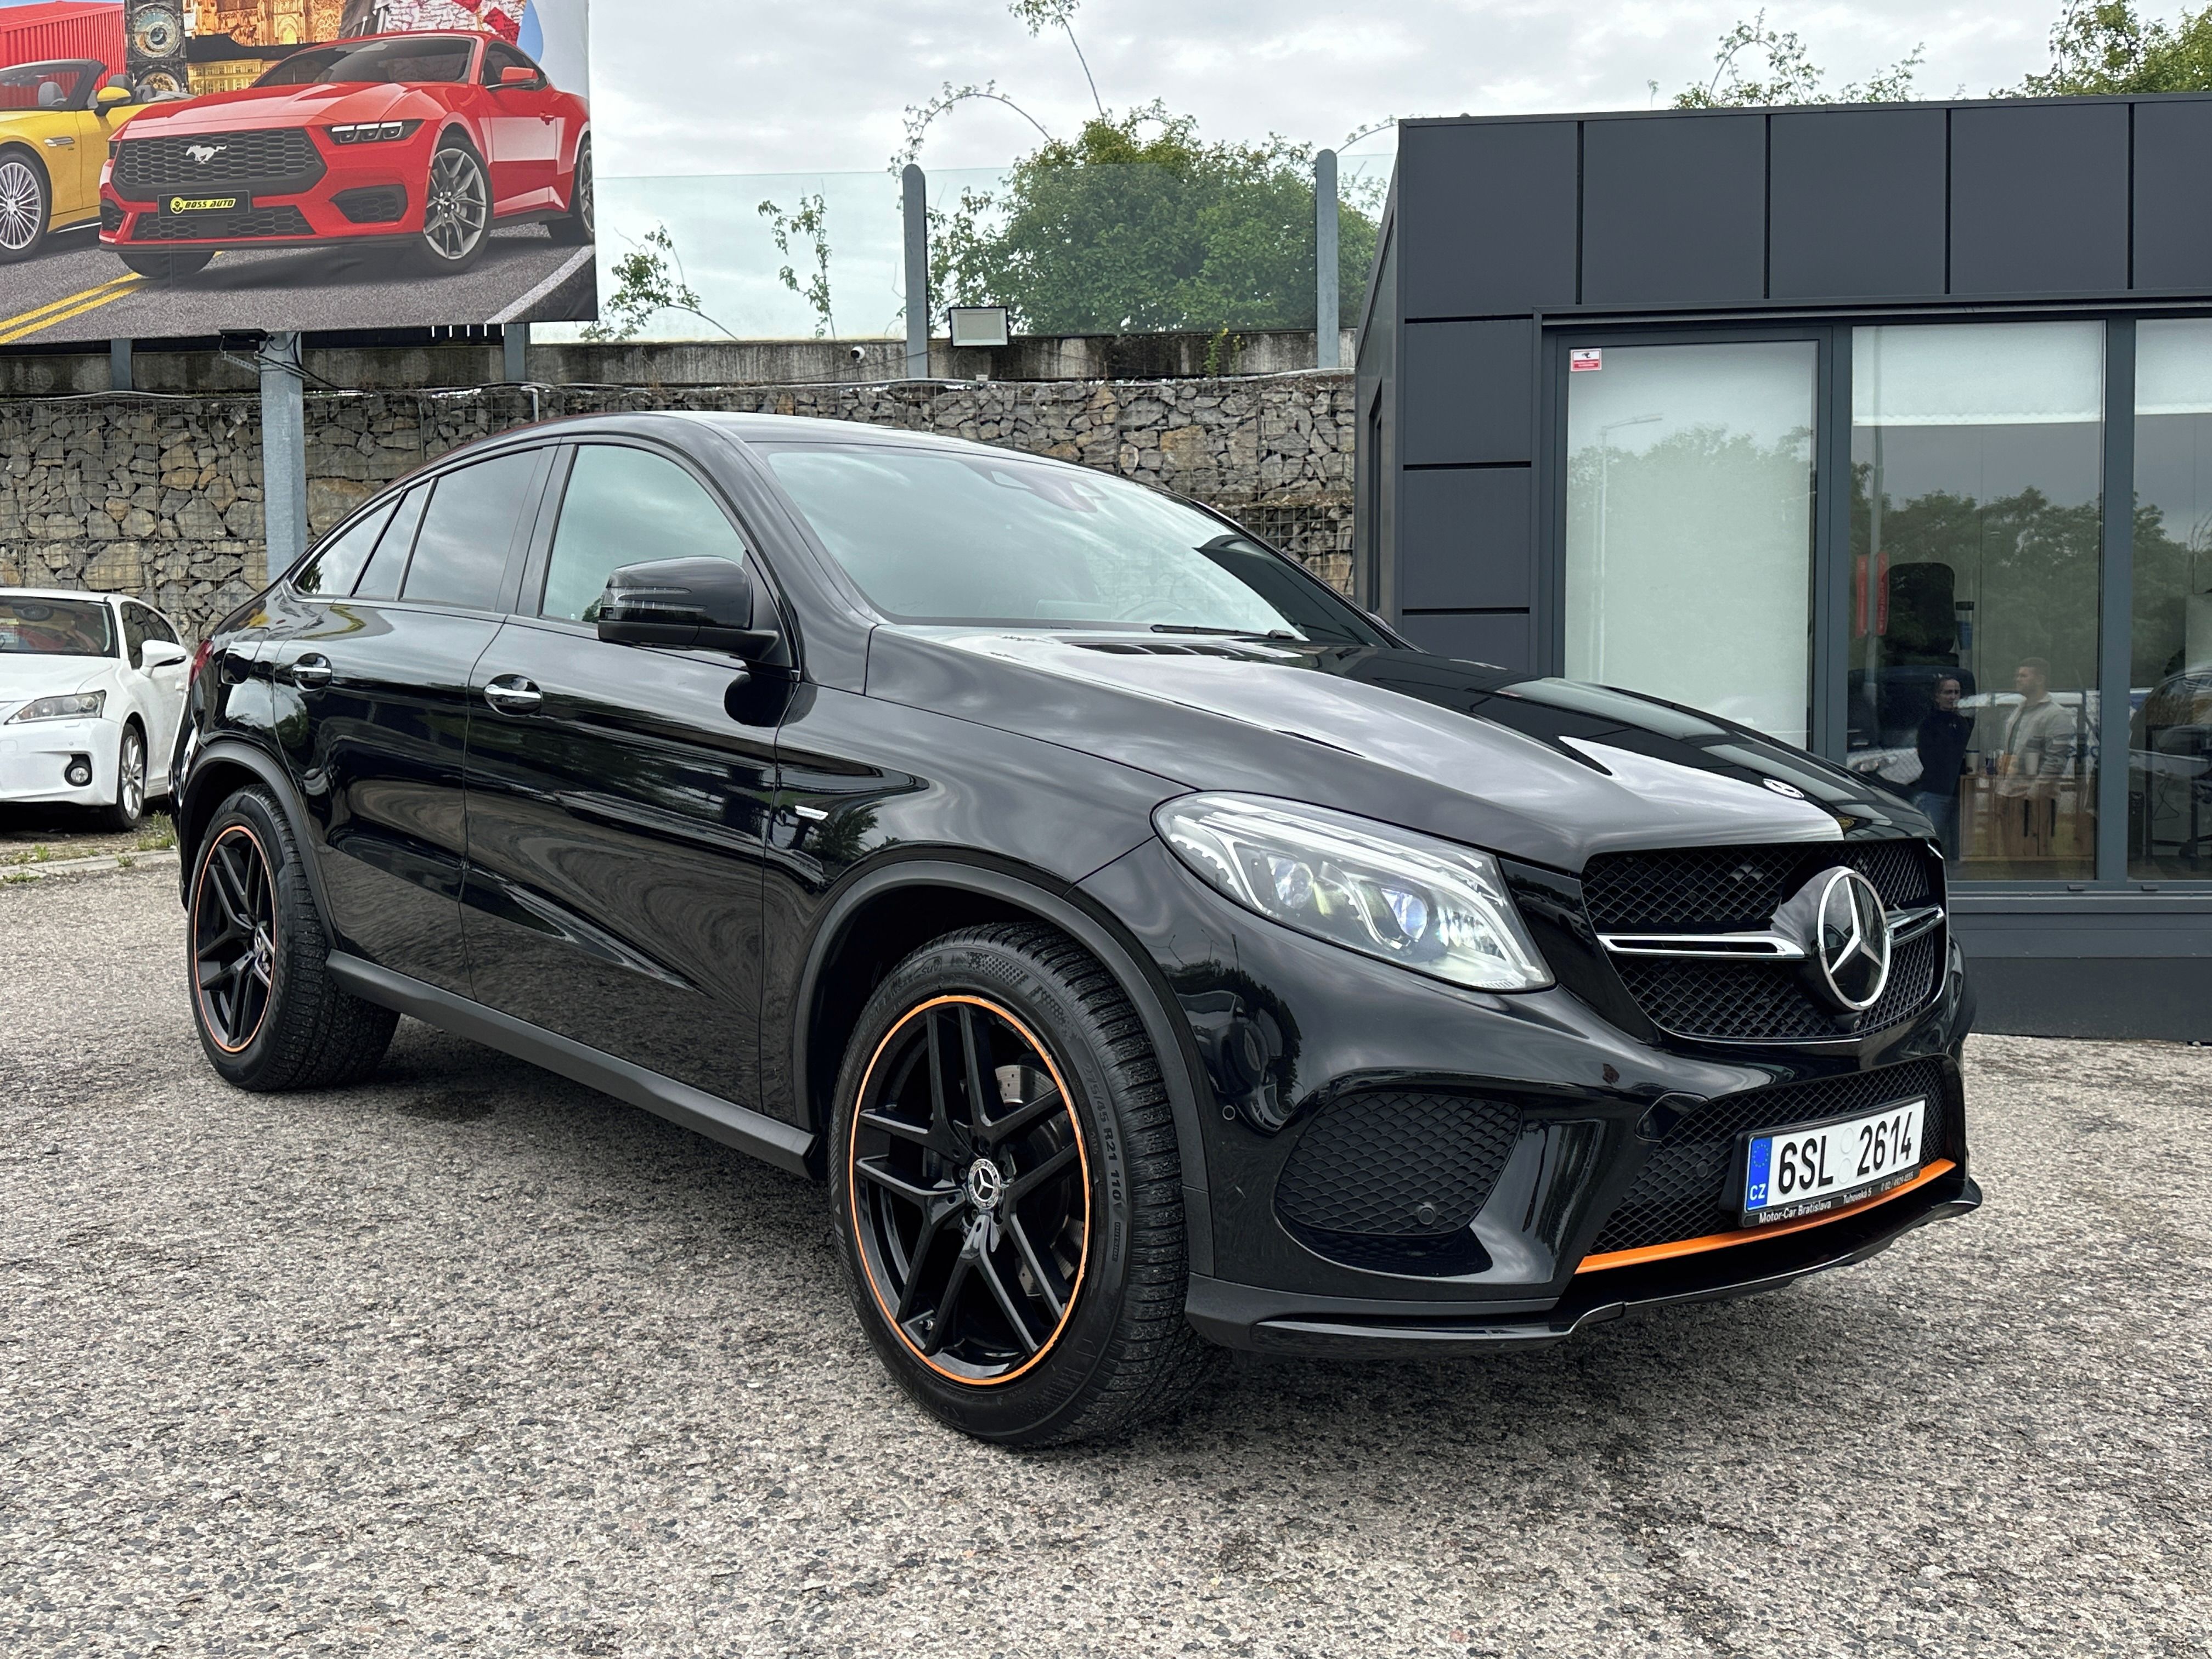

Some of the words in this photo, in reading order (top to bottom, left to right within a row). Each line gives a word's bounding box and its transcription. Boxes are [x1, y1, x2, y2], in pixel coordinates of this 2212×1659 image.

[1079, 1063, 1110, 1123] 275/45
[1103, 1127, 1118, 1162] R21
[1779, 1135, 1834, 1195] 6SL
[1857, 1111, 1913, 1177] 2614
[1749, 1183, 1766, 1201] CZ
[1758, 1207, 1797, 1224] Motor-Car
[1797, 1200, 1832, 1216] Bratislava
[1112, 1221, 1122, 1263] OUTSIDE
